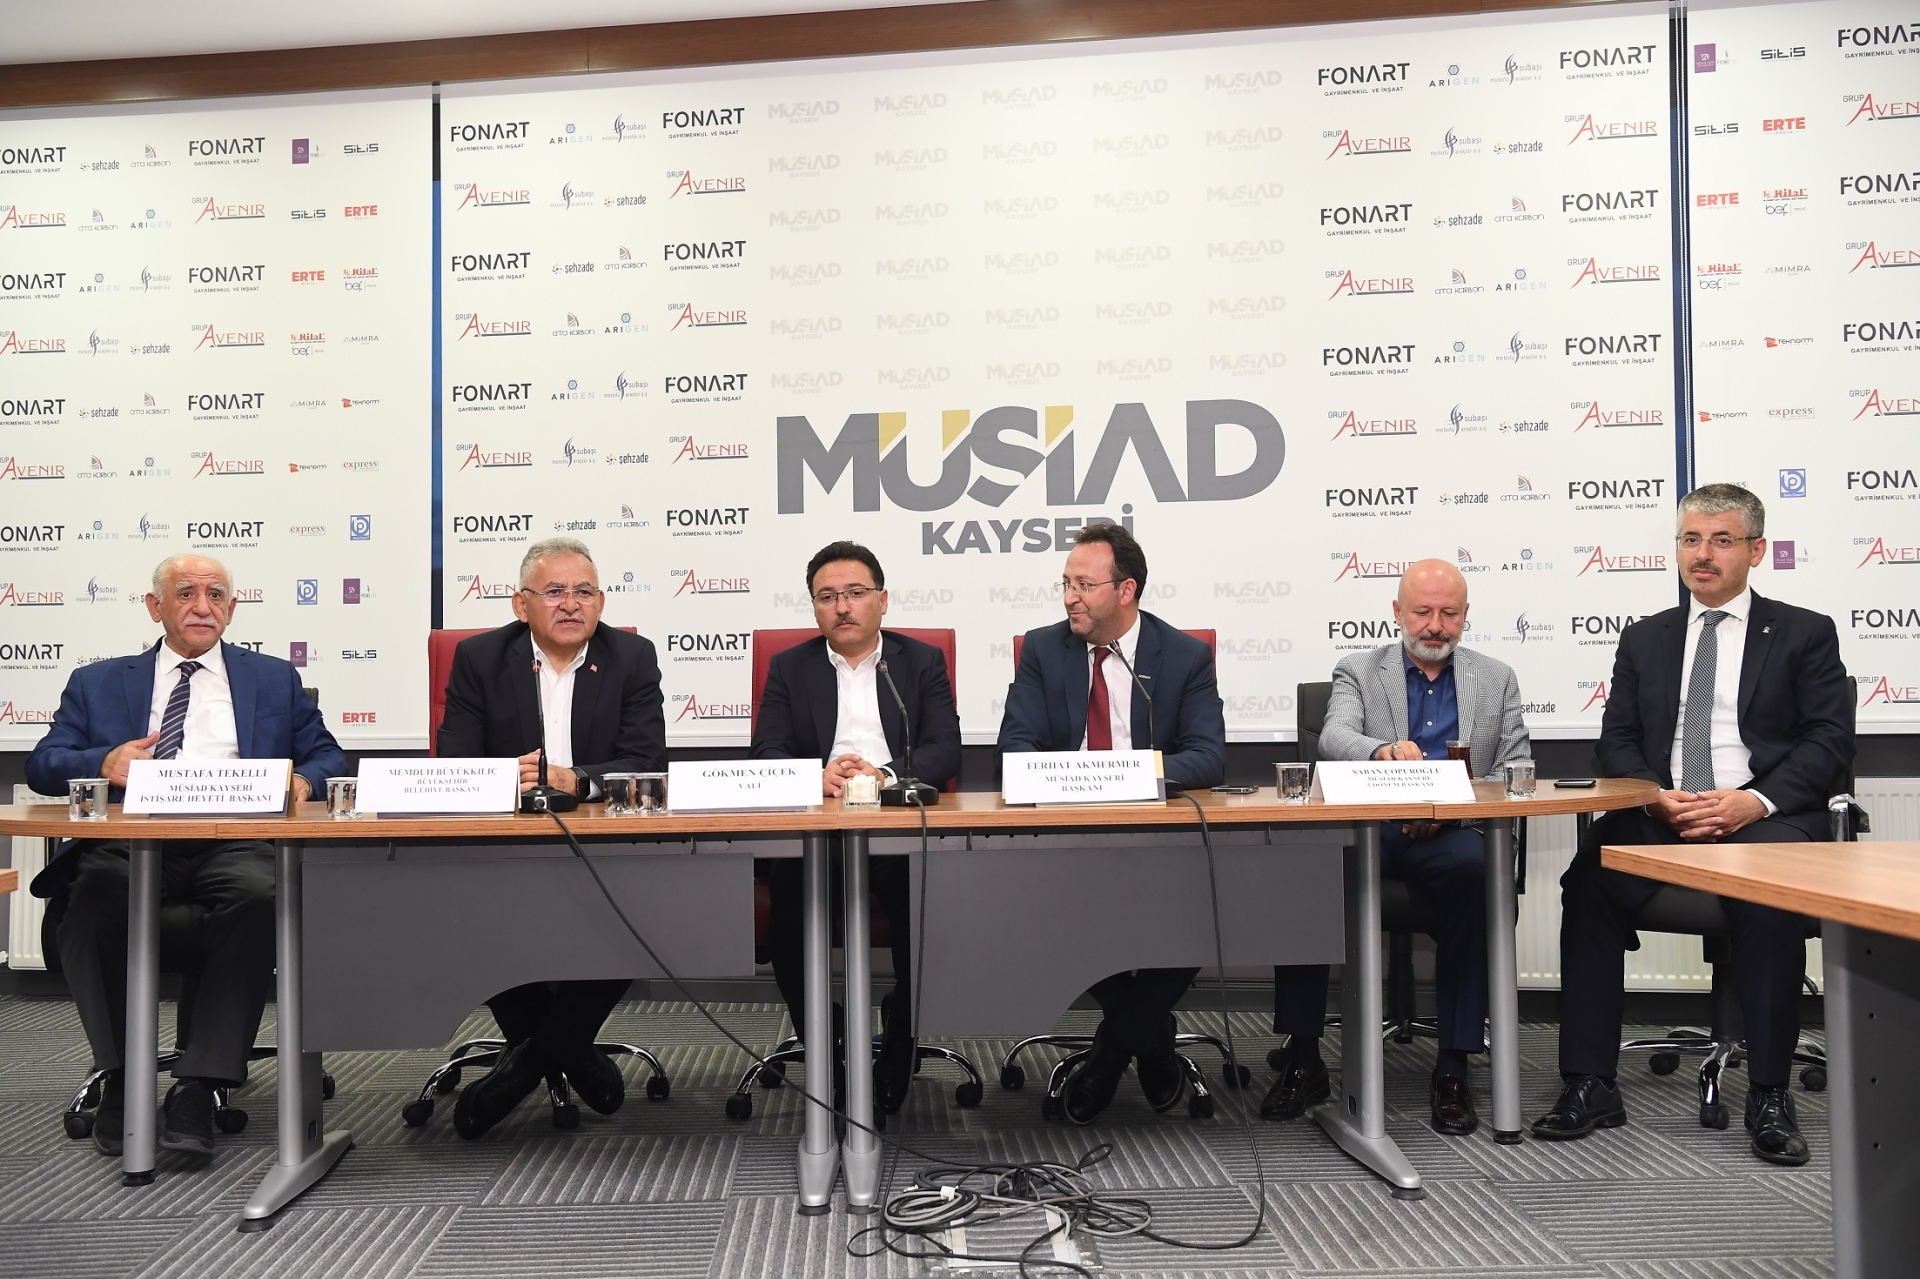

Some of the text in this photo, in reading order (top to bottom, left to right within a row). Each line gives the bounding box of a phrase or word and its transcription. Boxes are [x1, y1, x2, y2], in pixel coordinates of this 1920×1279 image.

[1560, 45, 1656, 69] FONART
[1318, 63, 1410, 86] FONART
[1843, 94, 1864, 102] GRUP
[663, 108, 745, 129] FONART
[1845, 94, 1920, 126] AVEN
[451, 122, 530, 142] FONART
[1567, 114, 1657, 145] AVENIR
[1763, 117, 1805, 131] ERTE
[189, 137, 265, 156] FONART
[1325, 130, 1411, 160] AVENIR
[0, 147, 66, 165] ONART
[192, 197, 208, 205] GRUP
[456, 183, 530, 211] AVENIR
[1563, 190, 1658, 212] FONART
[1697, 193, 1739, 206] ERTE
[194, 197, 265, 223] AVENIR
[345, 205, 377, 217] ERTE
[1321, 204, 1412, 226] FONART
[664, 241, 746, 261] FONART
[452, 252, 531, 272] FONART
[189, 265, 265, 283] FONART
[292, 271, 325, 282] ERTE
[1570, 257, 1660, 289] AVENIR
[670, 303, 747, 331] AVENIR
[457, 313, 531, 341] AVENIR
[194, 324, 265, 351] AVENIR
[1566, 334, 1662, 355] FONART
[1323, 345, 1415, 366] FONART
[453, 383, 532, 402] FONART
[666, 374, 748, 393] FONART
[188, 393, 265, 411] FONART
[1768, 407, 1813, 417] express
[1330, 411, 1417, 441] AVENIR
[193, 452, 264, 479] AVENIR
[458, 444, 532, 472] AVENIR
[1569, 479, 1665, 499] FONART
[1848, 470, 1918, 489] FONA
[1326, 487, 1418, 507] FONART
[454, 515, 533, 533] FONART
[667, 508, 749, 526] FONART
[188, 521, 264, 538] FONART
[290, 526, 325, 534] express
[922, 504, 1134, 555] KAYSEİ
[1576, 546, 1667, 577] AVENIR
[673, 569, 750, 598] AVENIR
[668, 634, 750, 651] FONART
[343, 712, 376, 723] ERTE
[158, 767, 267, 778] MUSTAFA TEKELLİ
[437, 767, 497, 776] BÜYÜKKILIÇ
[703, 767, 796, 777] GÖKMEN ÇİÇEK
[1075, 760, 1140, 769] AKMERMER
[169, 783, 252, 792] MÜSİAD KAYSERİ
[739, 781, 760, 789] VALİ
[1062, 785, 1102, 793] BAŞKANI
[140, 794, 271, 803] İSTİŞARE HEYETİ BAŞKANI
